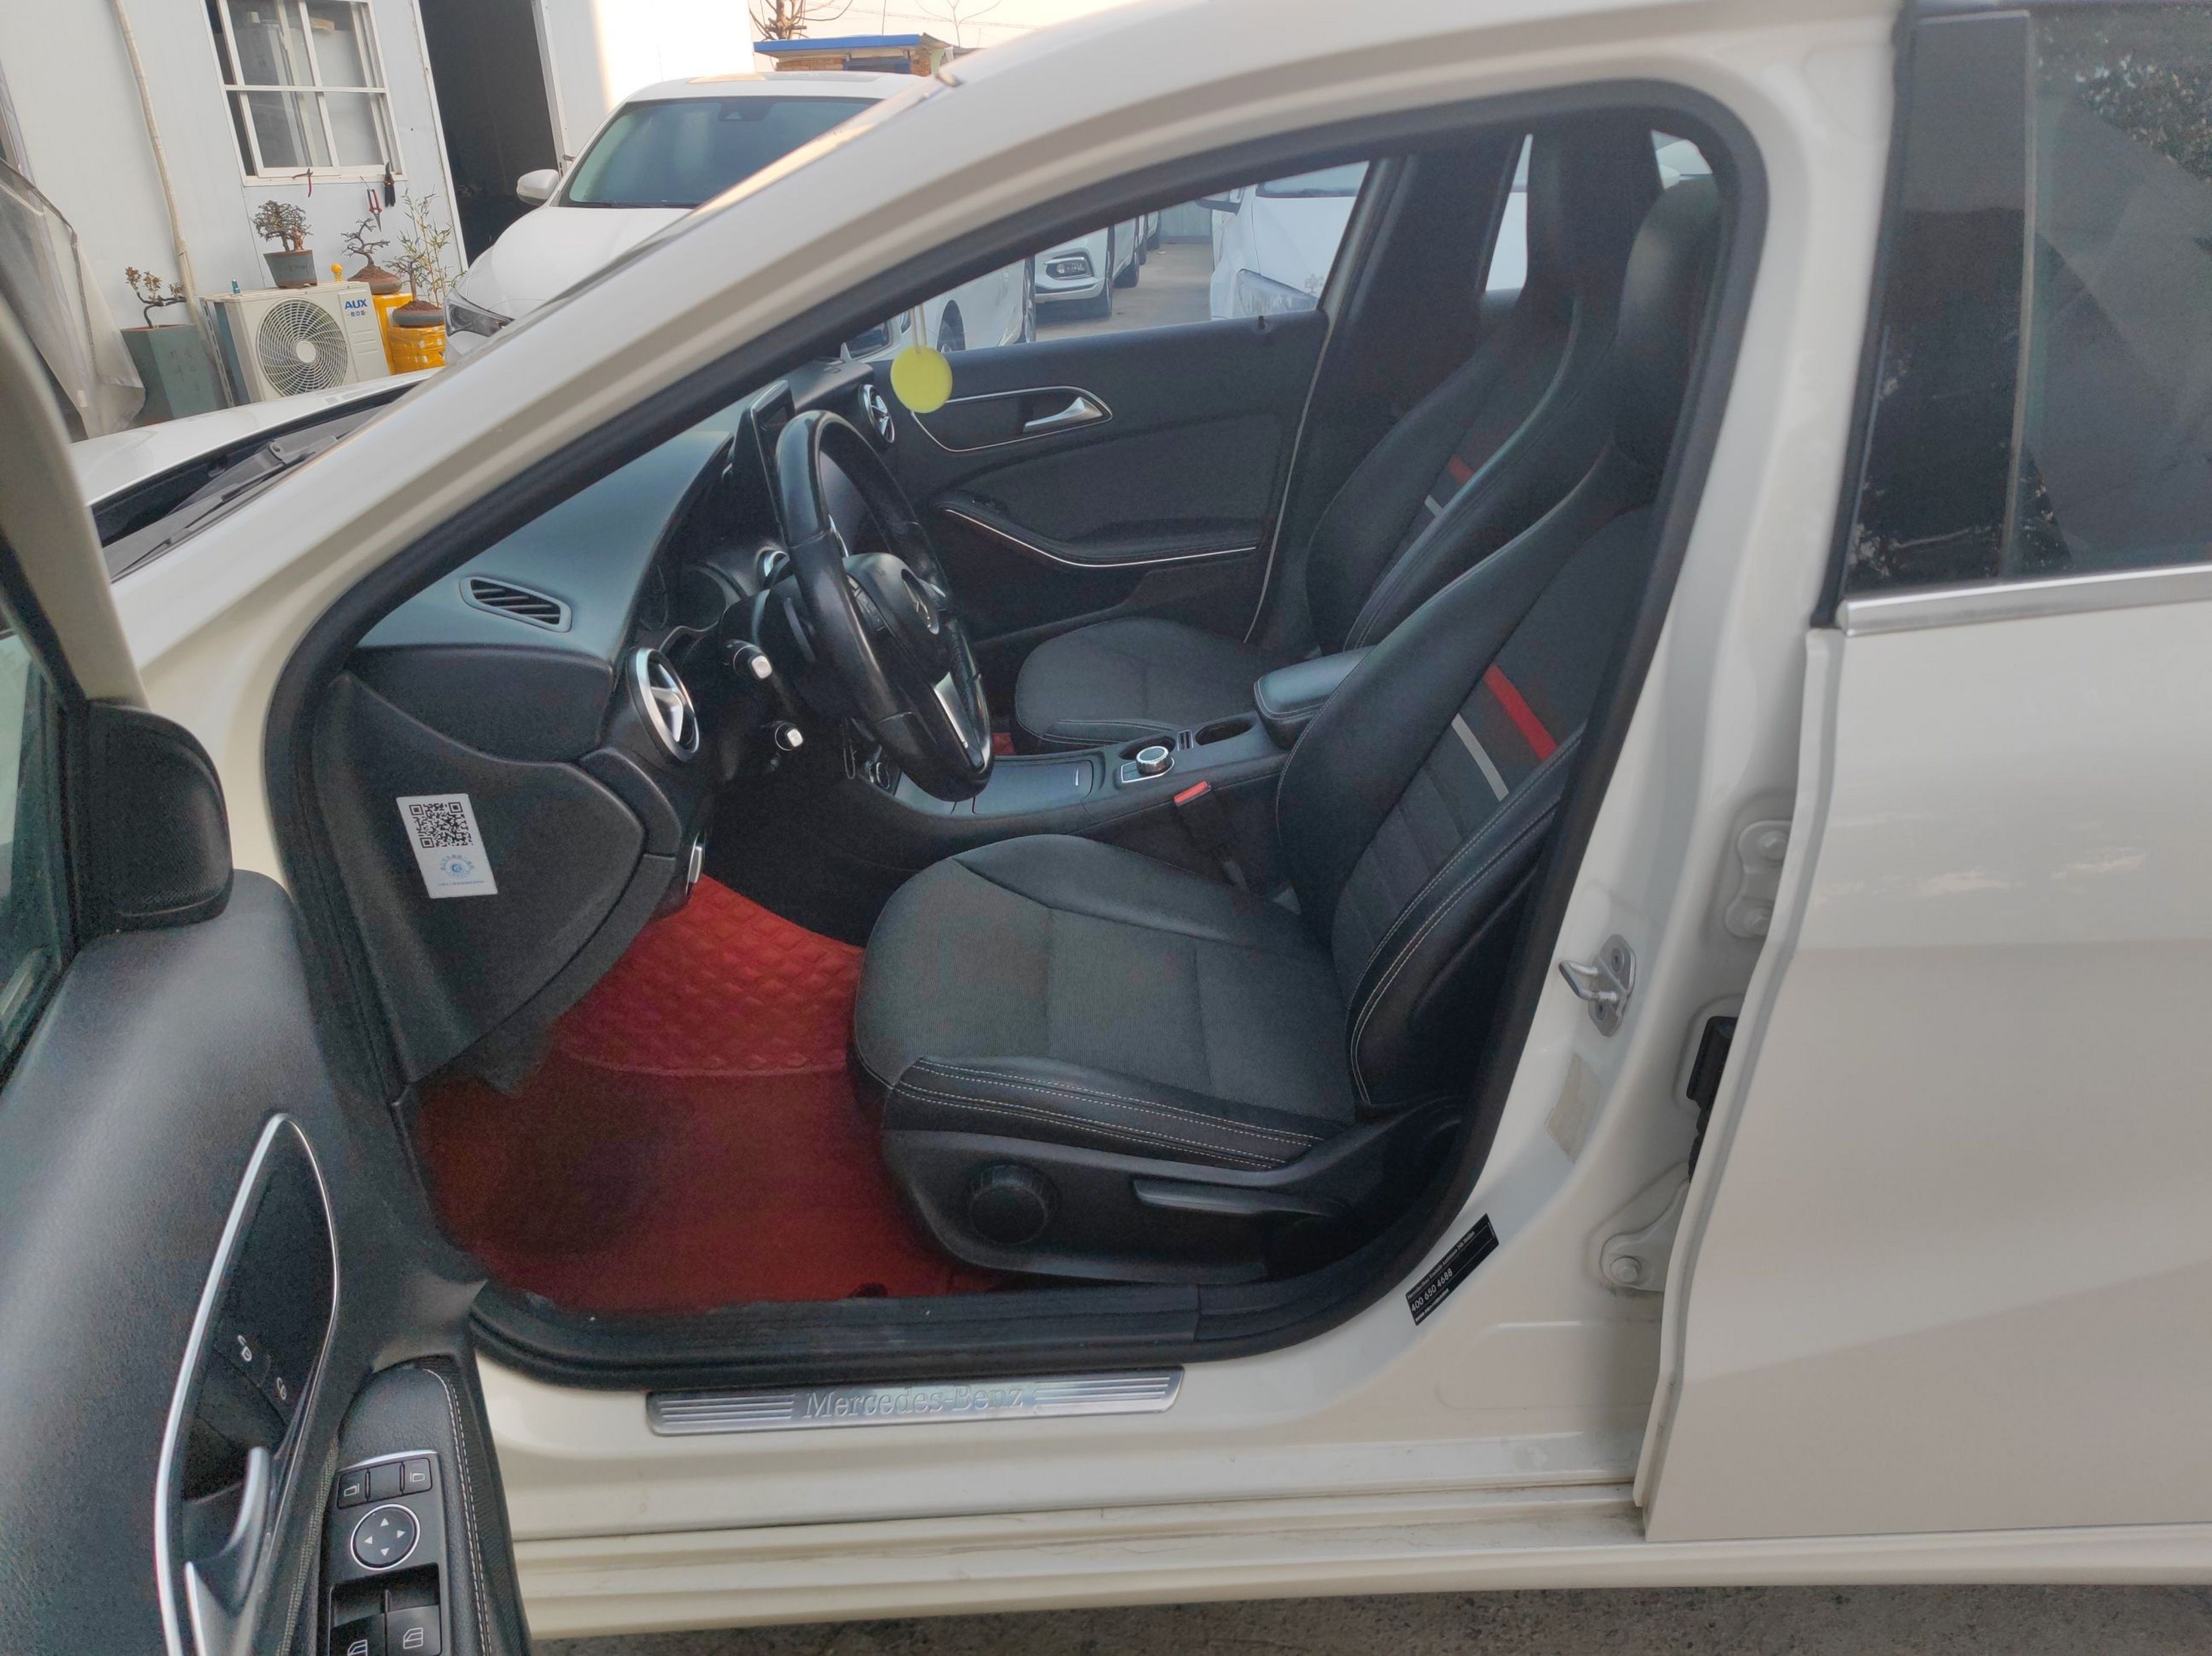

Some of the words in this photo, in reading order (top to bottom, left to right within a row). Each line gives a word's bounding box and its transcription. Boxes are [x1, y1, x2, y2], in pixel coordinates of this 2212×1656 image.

[345, 299, 368, 309] AUX
[1411, 1296, 1424, 1311] 400
[1425, 1284, 1436, 1300] 650
[1437, 1268, 1453, 1287] 4688
[802, 1384, 1024, 1419] Mercedes-Benz
